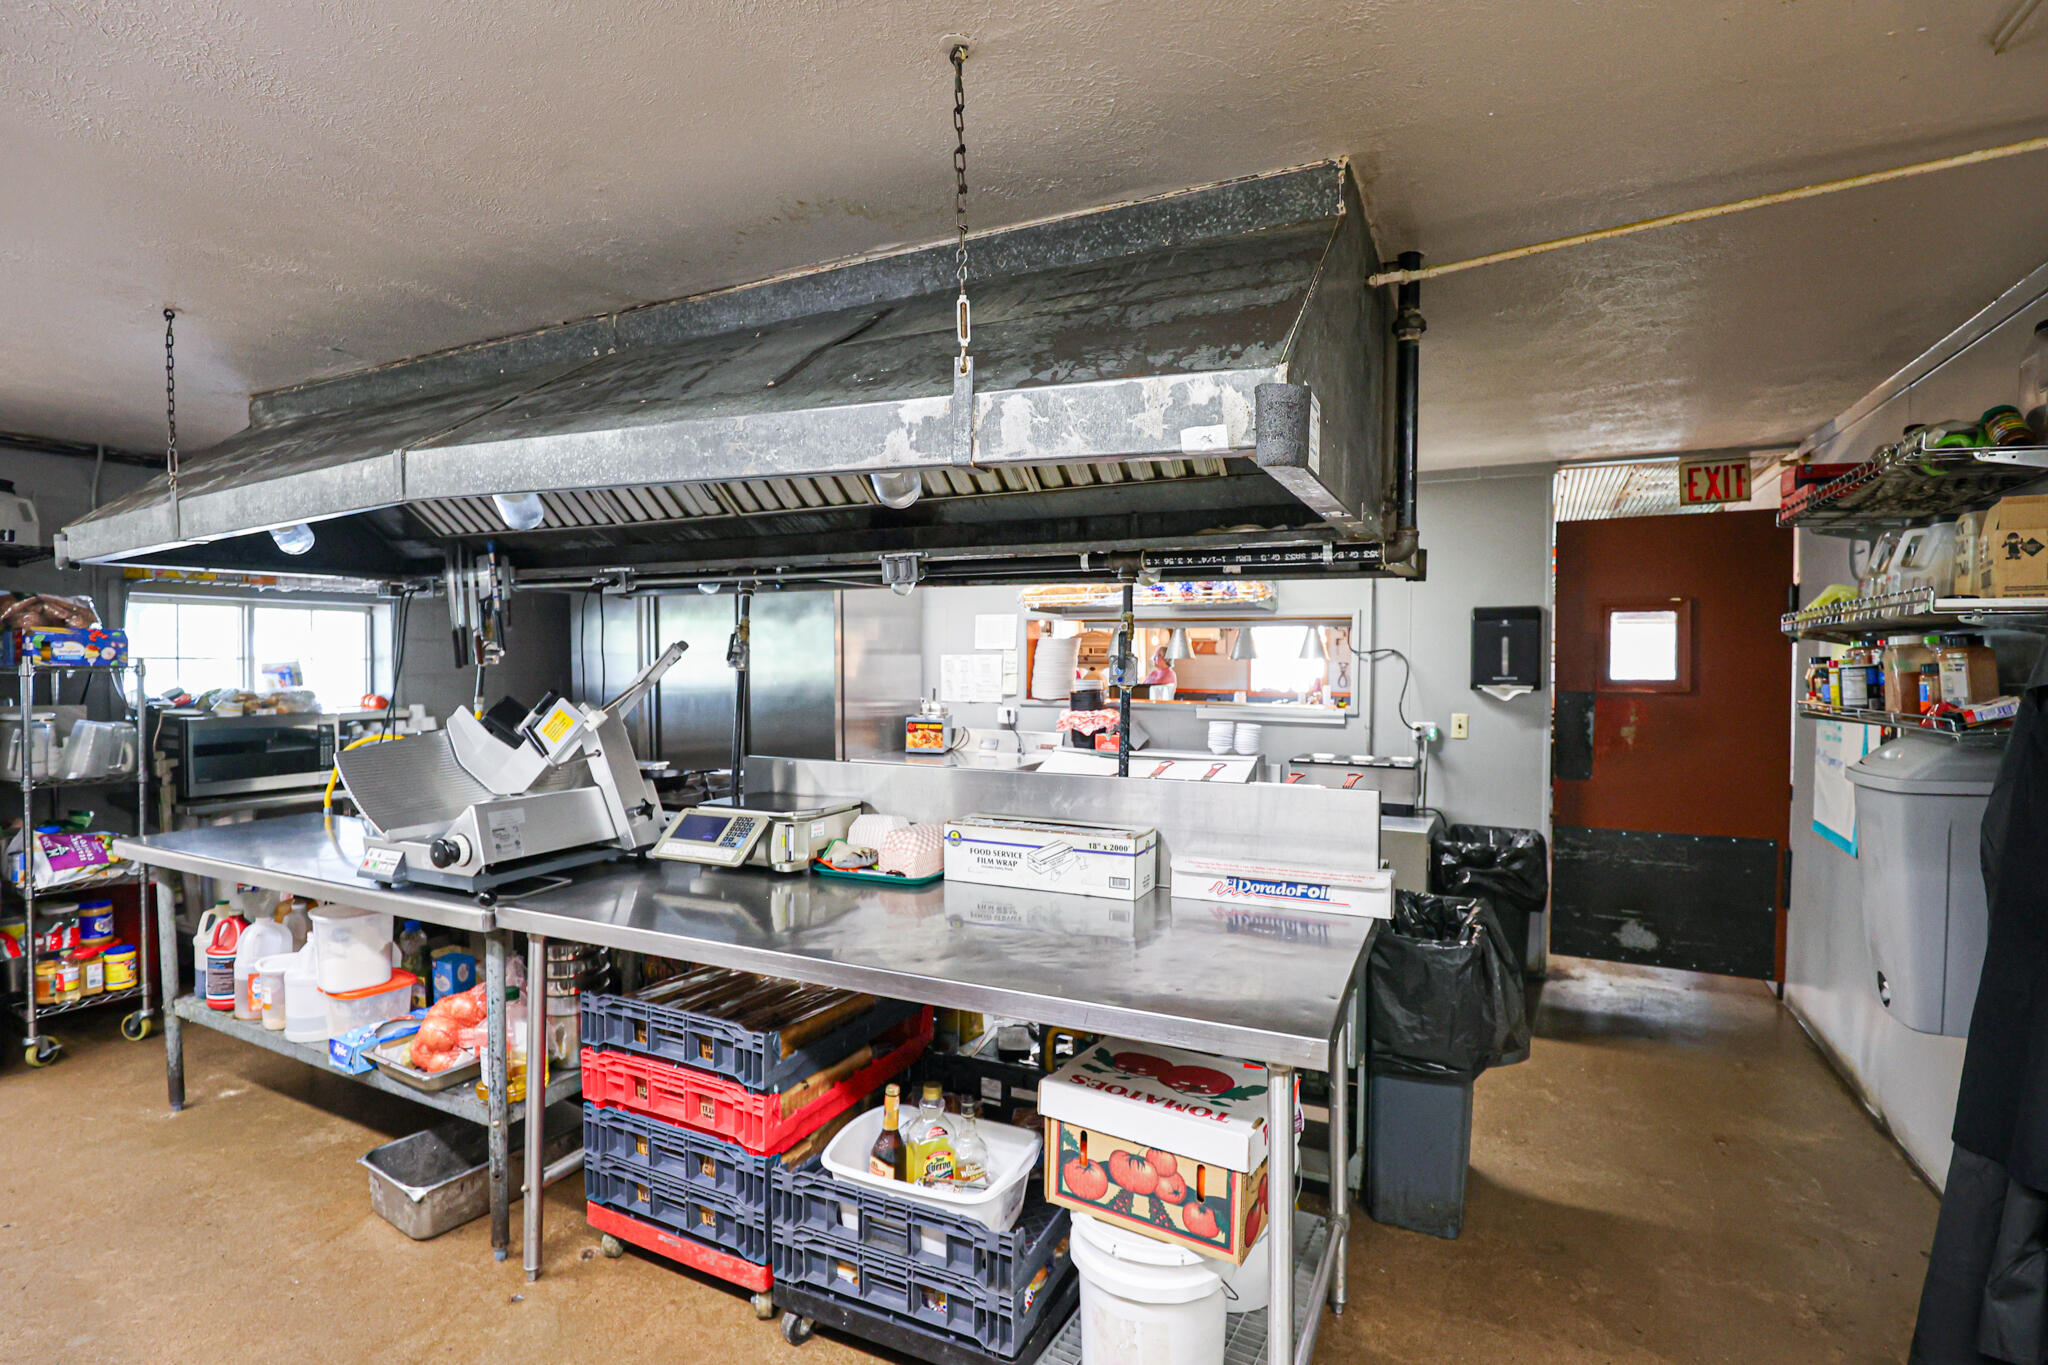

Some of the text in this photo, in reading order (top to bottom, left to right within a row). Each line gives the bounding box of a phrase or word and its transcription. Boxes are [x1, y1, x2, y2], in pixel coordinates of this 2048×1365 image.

[1687, 463, 1747, 502] EXIT
[969, 847, 1023, 860] FOOD SERVICE
[977, 856, 1018, 868] FILM WRAP
[1068, 1073, 1232, 1124] TOMATOES
[926, 1161, 951, 1175] Cuervo
